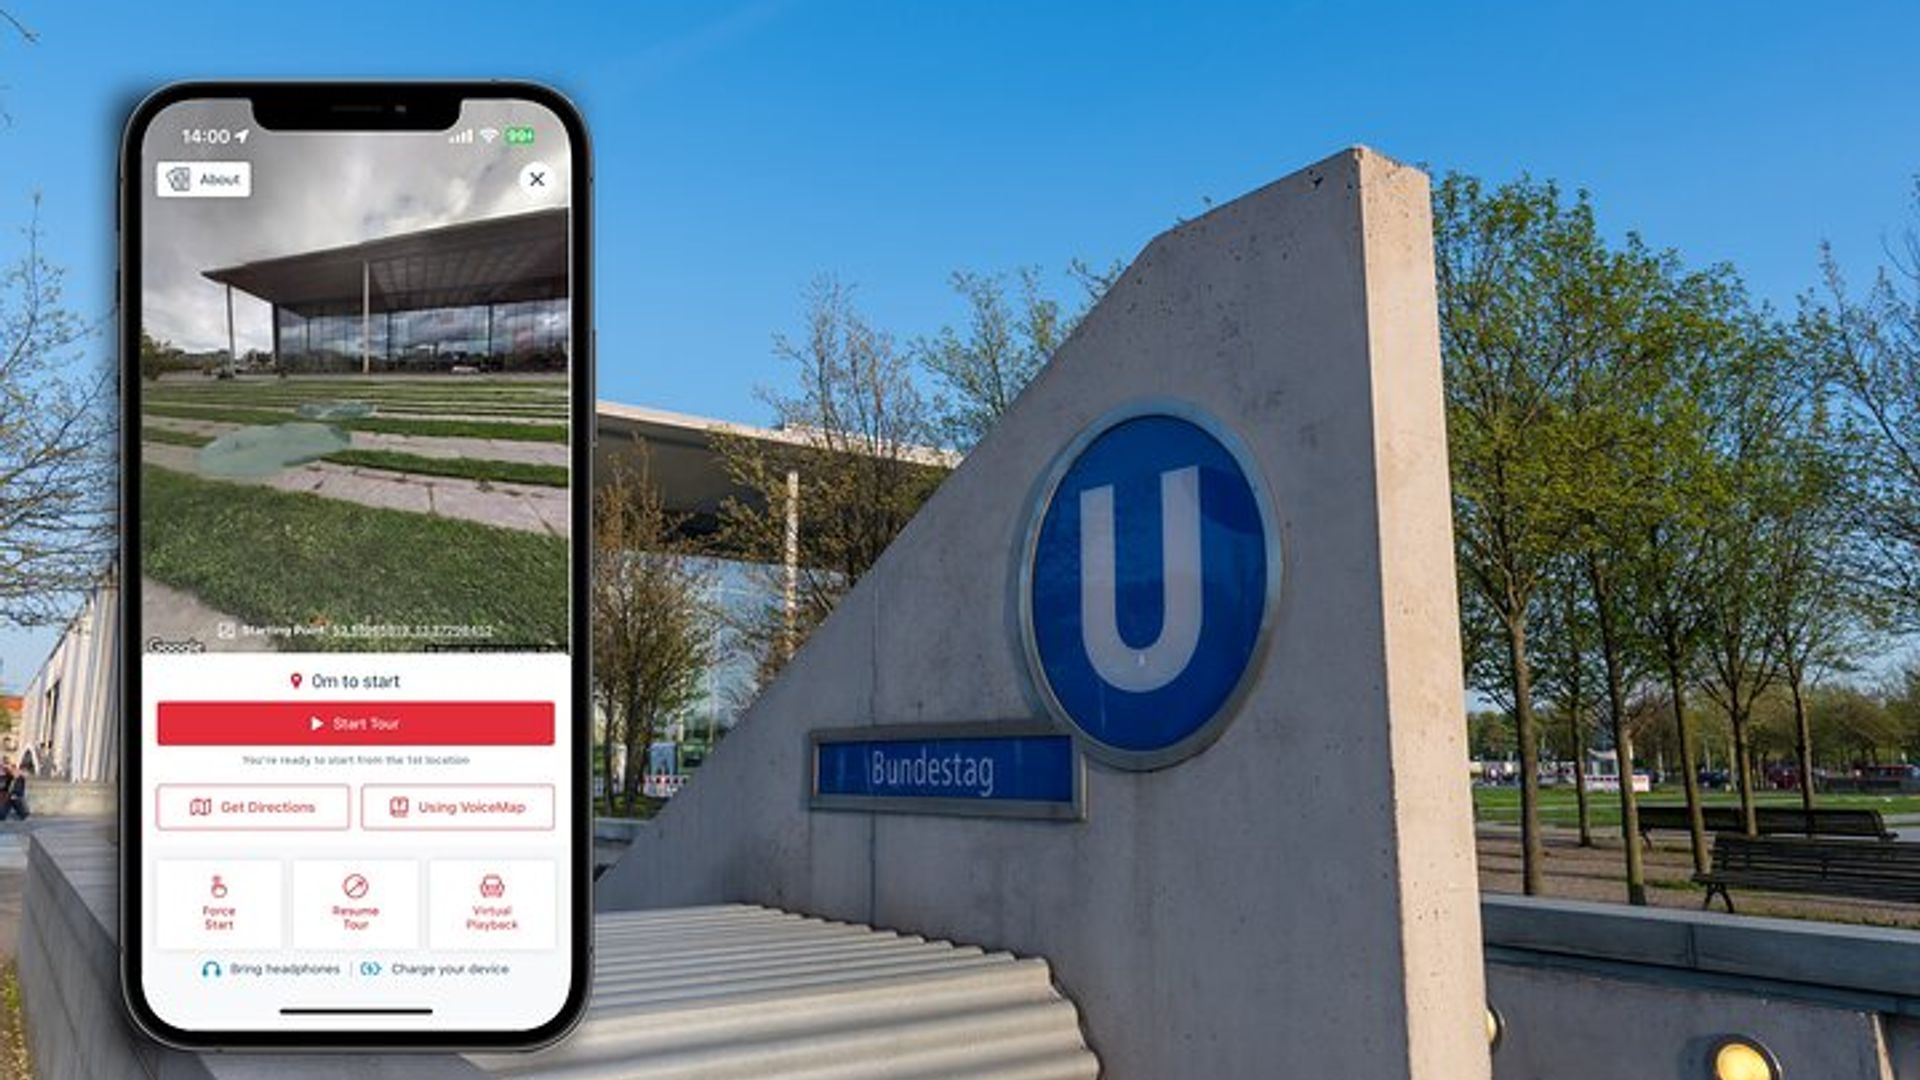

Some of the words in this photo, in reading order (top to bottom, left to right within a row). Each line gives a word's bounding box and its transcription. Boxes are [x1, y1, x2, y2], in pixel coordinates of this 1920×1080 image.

[182, 129, 231, 144] 14:00
[200, 173, 240, 186] About
[1080, 465, 1203, 693] U
[342, 675, 359, 688] to
[362, 675, 400, 688] start
[333, 716, 367, 731] Start
[370, 717, 400, 731] Tour
[242, 755, 277, 766] You're
[280, 755, 311, 767] ready
[314, 755, 326, 766] to
[328, 755, 354, 766] start
[357, 755, 383, 766] from
[386, 755, 404, 766] the
[425, 755, 470, 766] location
[872, 746, 994, 798] Bundestag
[221, 800, 245, 814] Get
[248, 800, 316, 814] Directions
[418, 801, 457, 816] Using
[461, 801, 526, 815] VoiceMap
[203, 905, 236, 917] Force
[332, 905, 380, 917] Resume
[472, 905, 513, 917] Virtual
[205, 918, 233, 930] Start
[343, 918, 370, 930] Tour
[466, 918, 519, 932] Playback
[230, 963, 263, 977] Bring
[266, 963, 340, 977] headphones
[392, 963, 435, 977] Charge
[439, 965, 464, 977] your
[468, 963, 510, 976] device
